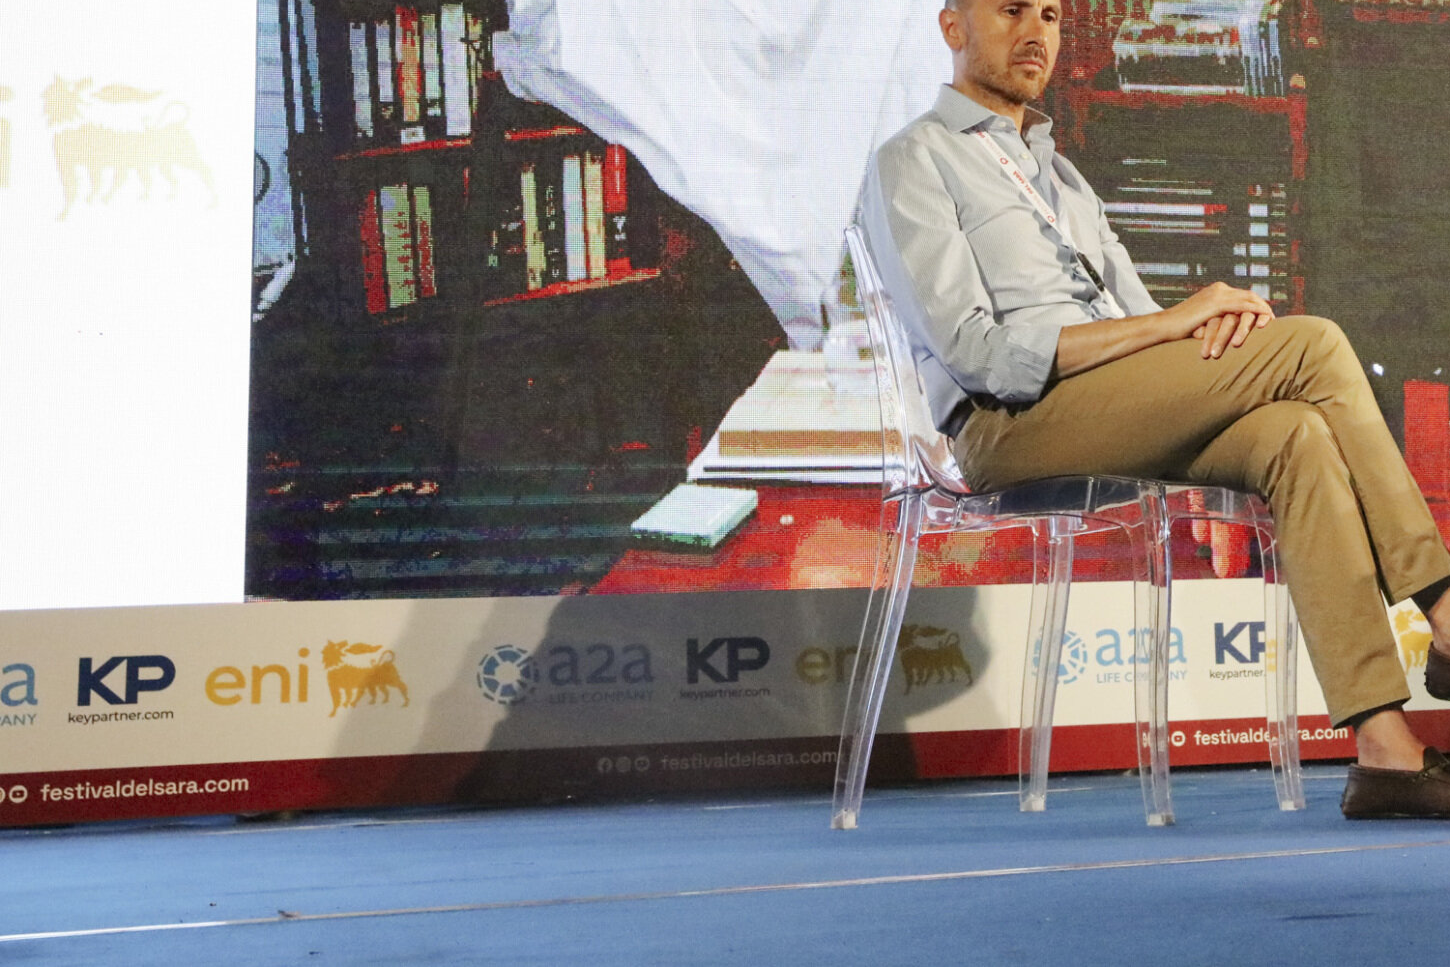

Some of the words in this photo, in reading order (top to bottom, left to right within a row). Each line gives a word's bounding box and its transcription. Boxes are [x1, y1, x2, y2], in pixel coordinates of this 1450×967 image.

[549, 643, 655, 685] a2a
[686, 636, 771, 685] KP
[795, 645, 874, 685] en
[77, 654, 176, 707] KP
[205, 647, 310, 707] eni
[1096, 671, 1122, 684] LIFE
[1209, 668, 1266, 681] keypartner.
[680, 686, 771, 701] keypartner.com
[68, 708, 175, 726] keypartner.com
[1193, 726, 1348, 746] festivaldea.com
[660, 749, 839, 772] festivaldelsara.com
[40, 778, 250, 803] festivaldelsara.com
